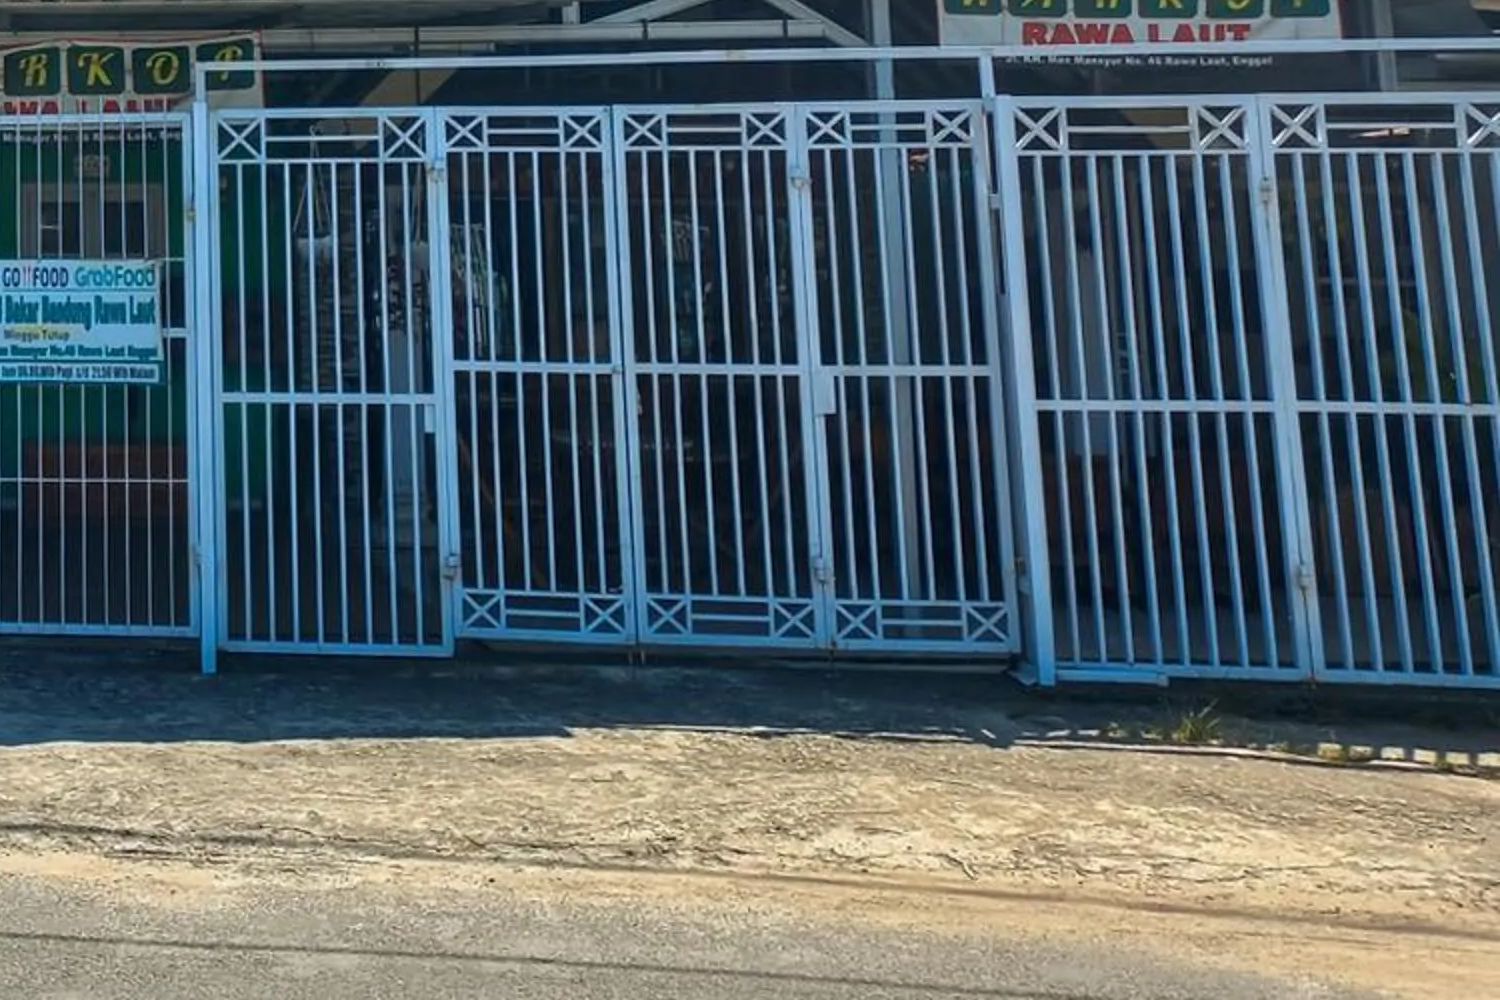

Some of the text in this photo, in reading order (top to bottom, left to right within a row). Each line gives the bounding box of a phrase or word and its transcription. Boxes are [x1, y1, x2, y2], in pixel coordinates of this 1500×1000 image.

[1022, 22, 1251, 45] RAWA LAUT
[3, 267, 21, 287] GO
[33, 267, 69, 287] FOOD
[74, 264, 155, 287] GrabFood
